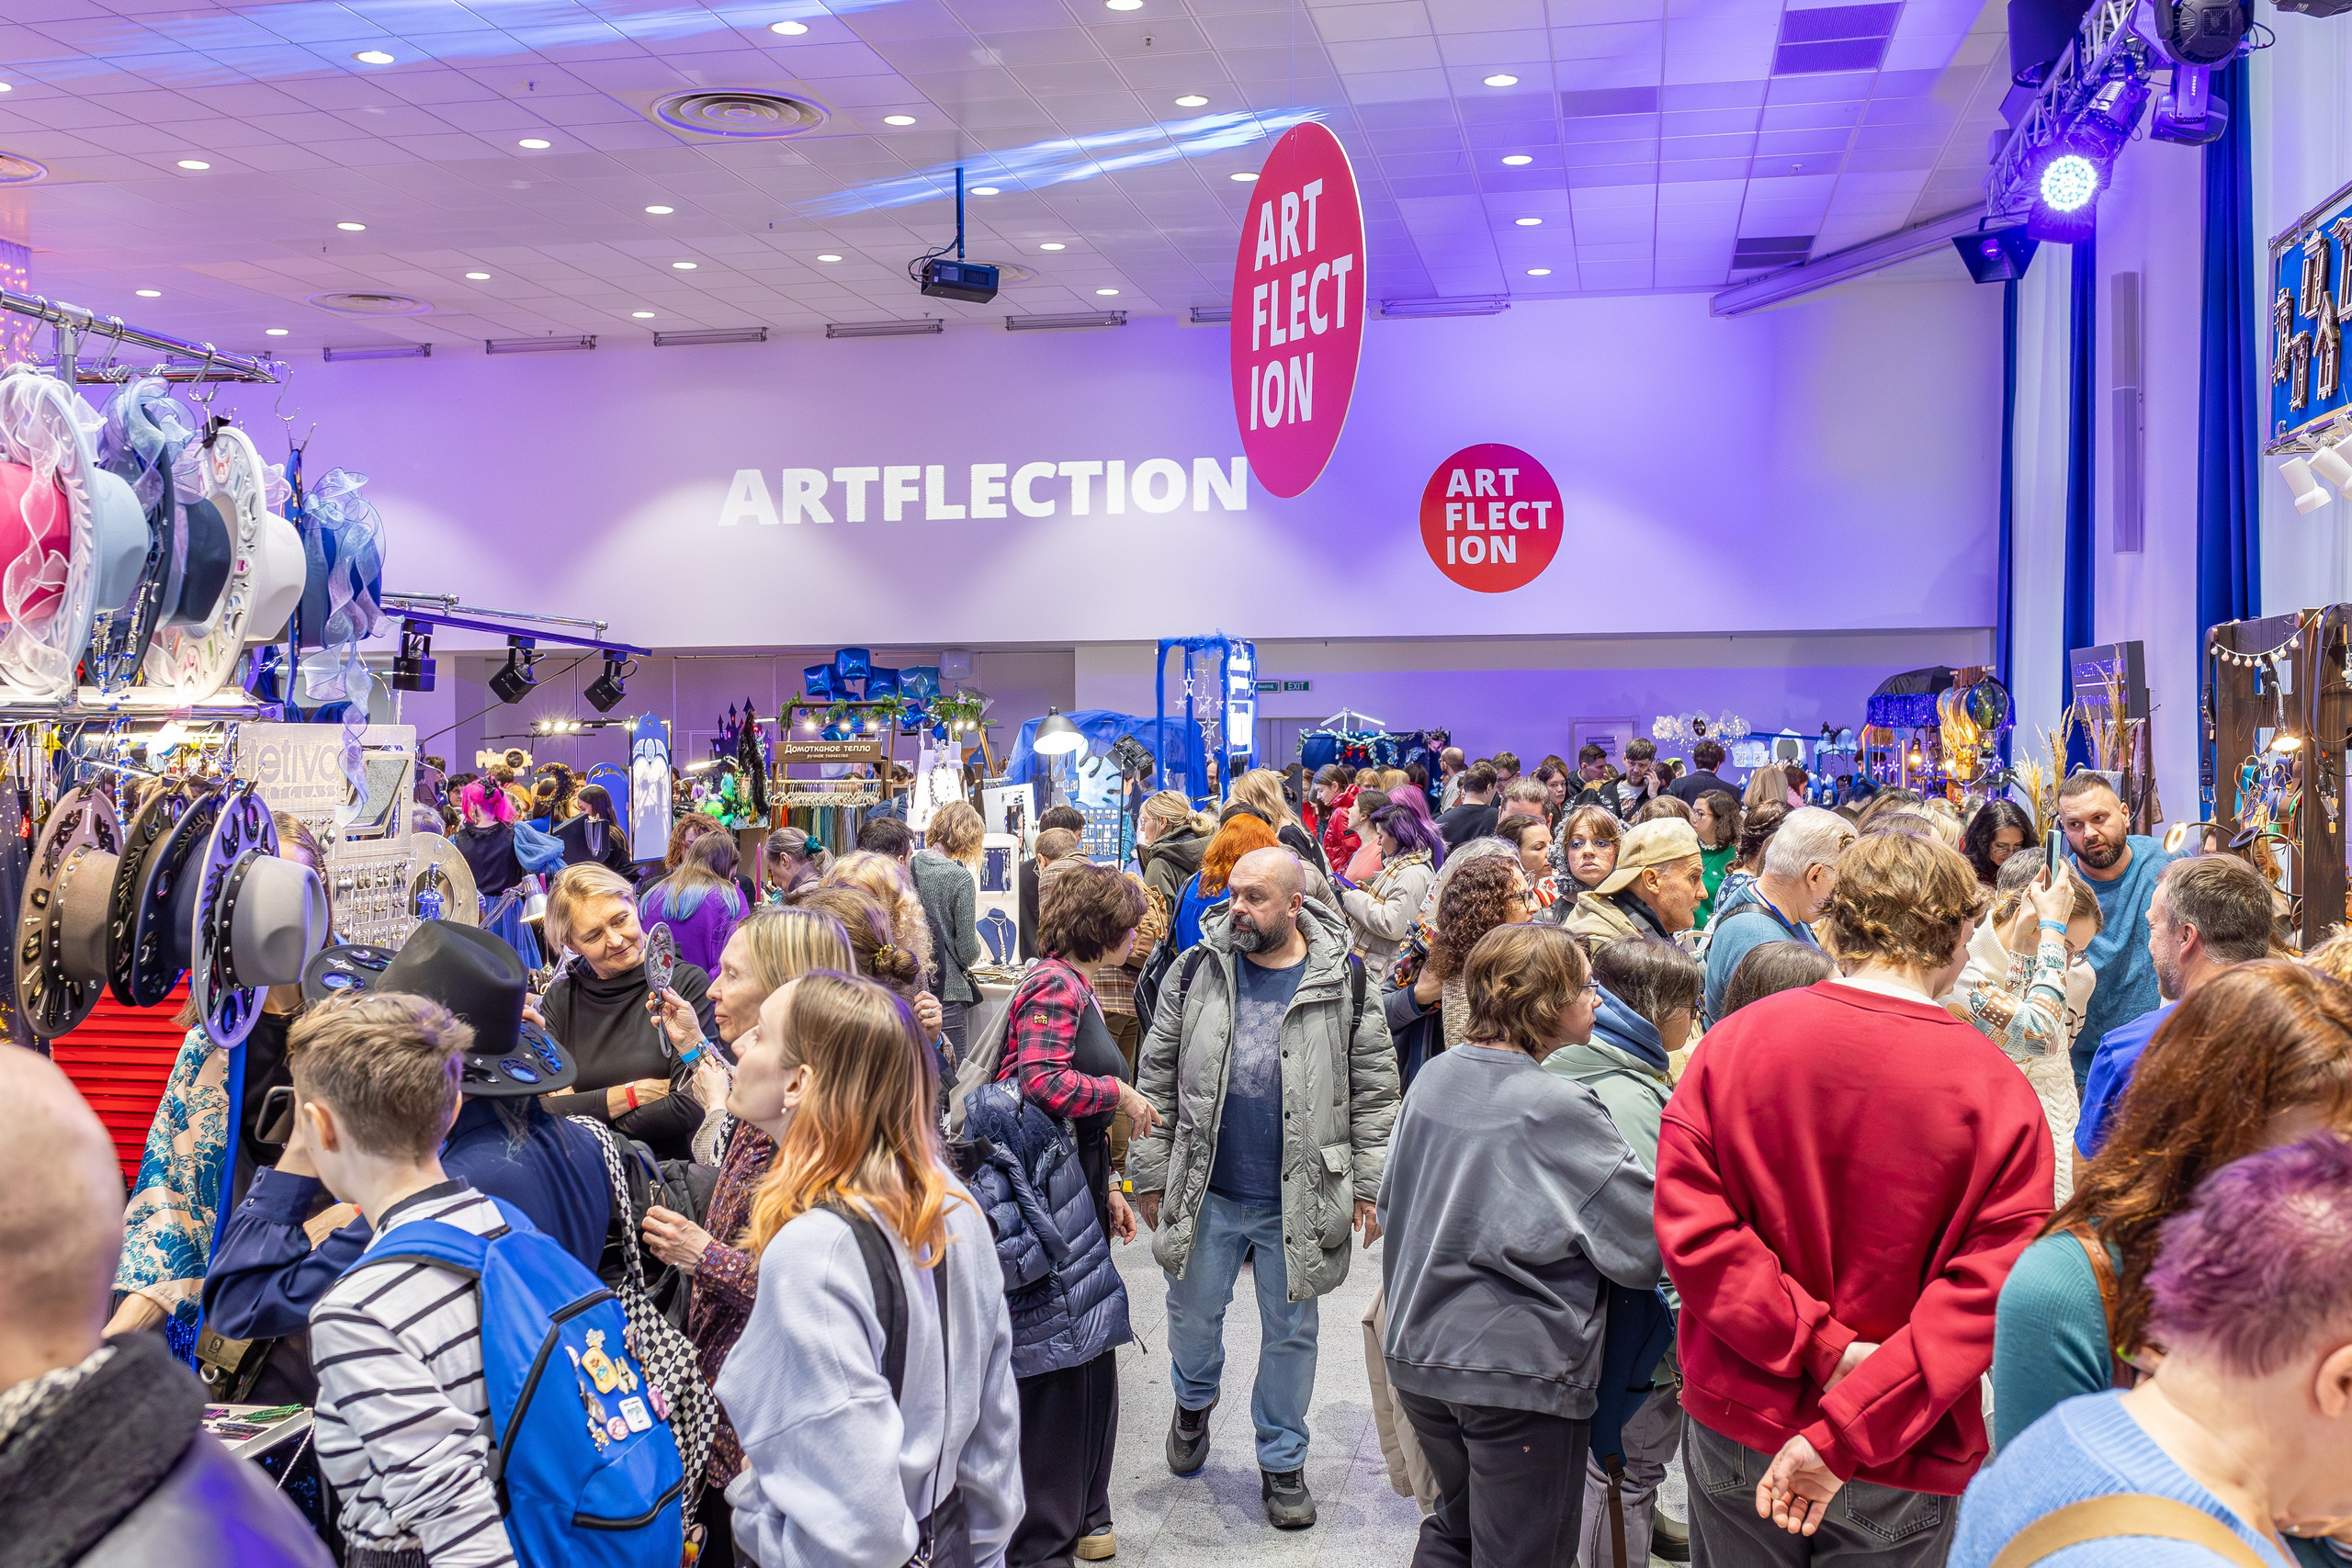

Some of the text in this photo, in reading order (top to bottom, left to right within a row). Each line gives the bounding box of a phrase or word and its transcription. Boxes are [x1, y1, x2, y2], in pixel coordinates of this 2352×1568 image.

[1254, 178, 1323, 272] ART
[1252, 254, 1353, 351] FLECT
[1250, 352, 1314, 431] ION
[718, 456, 1247, 526] ARTFLECTION
[1445, 468, 1520, 497] ART
[1445, 501, 1553, 531] FLECT
[1446, 535, 1517, 565] ION
[1287, 682, 1305, 690] EXIT
[249, 739, 340, 784] tetiva
[785, 744, 871, 754] Домотканое тепло
[258, 786, 339, 799] RTGLASS
